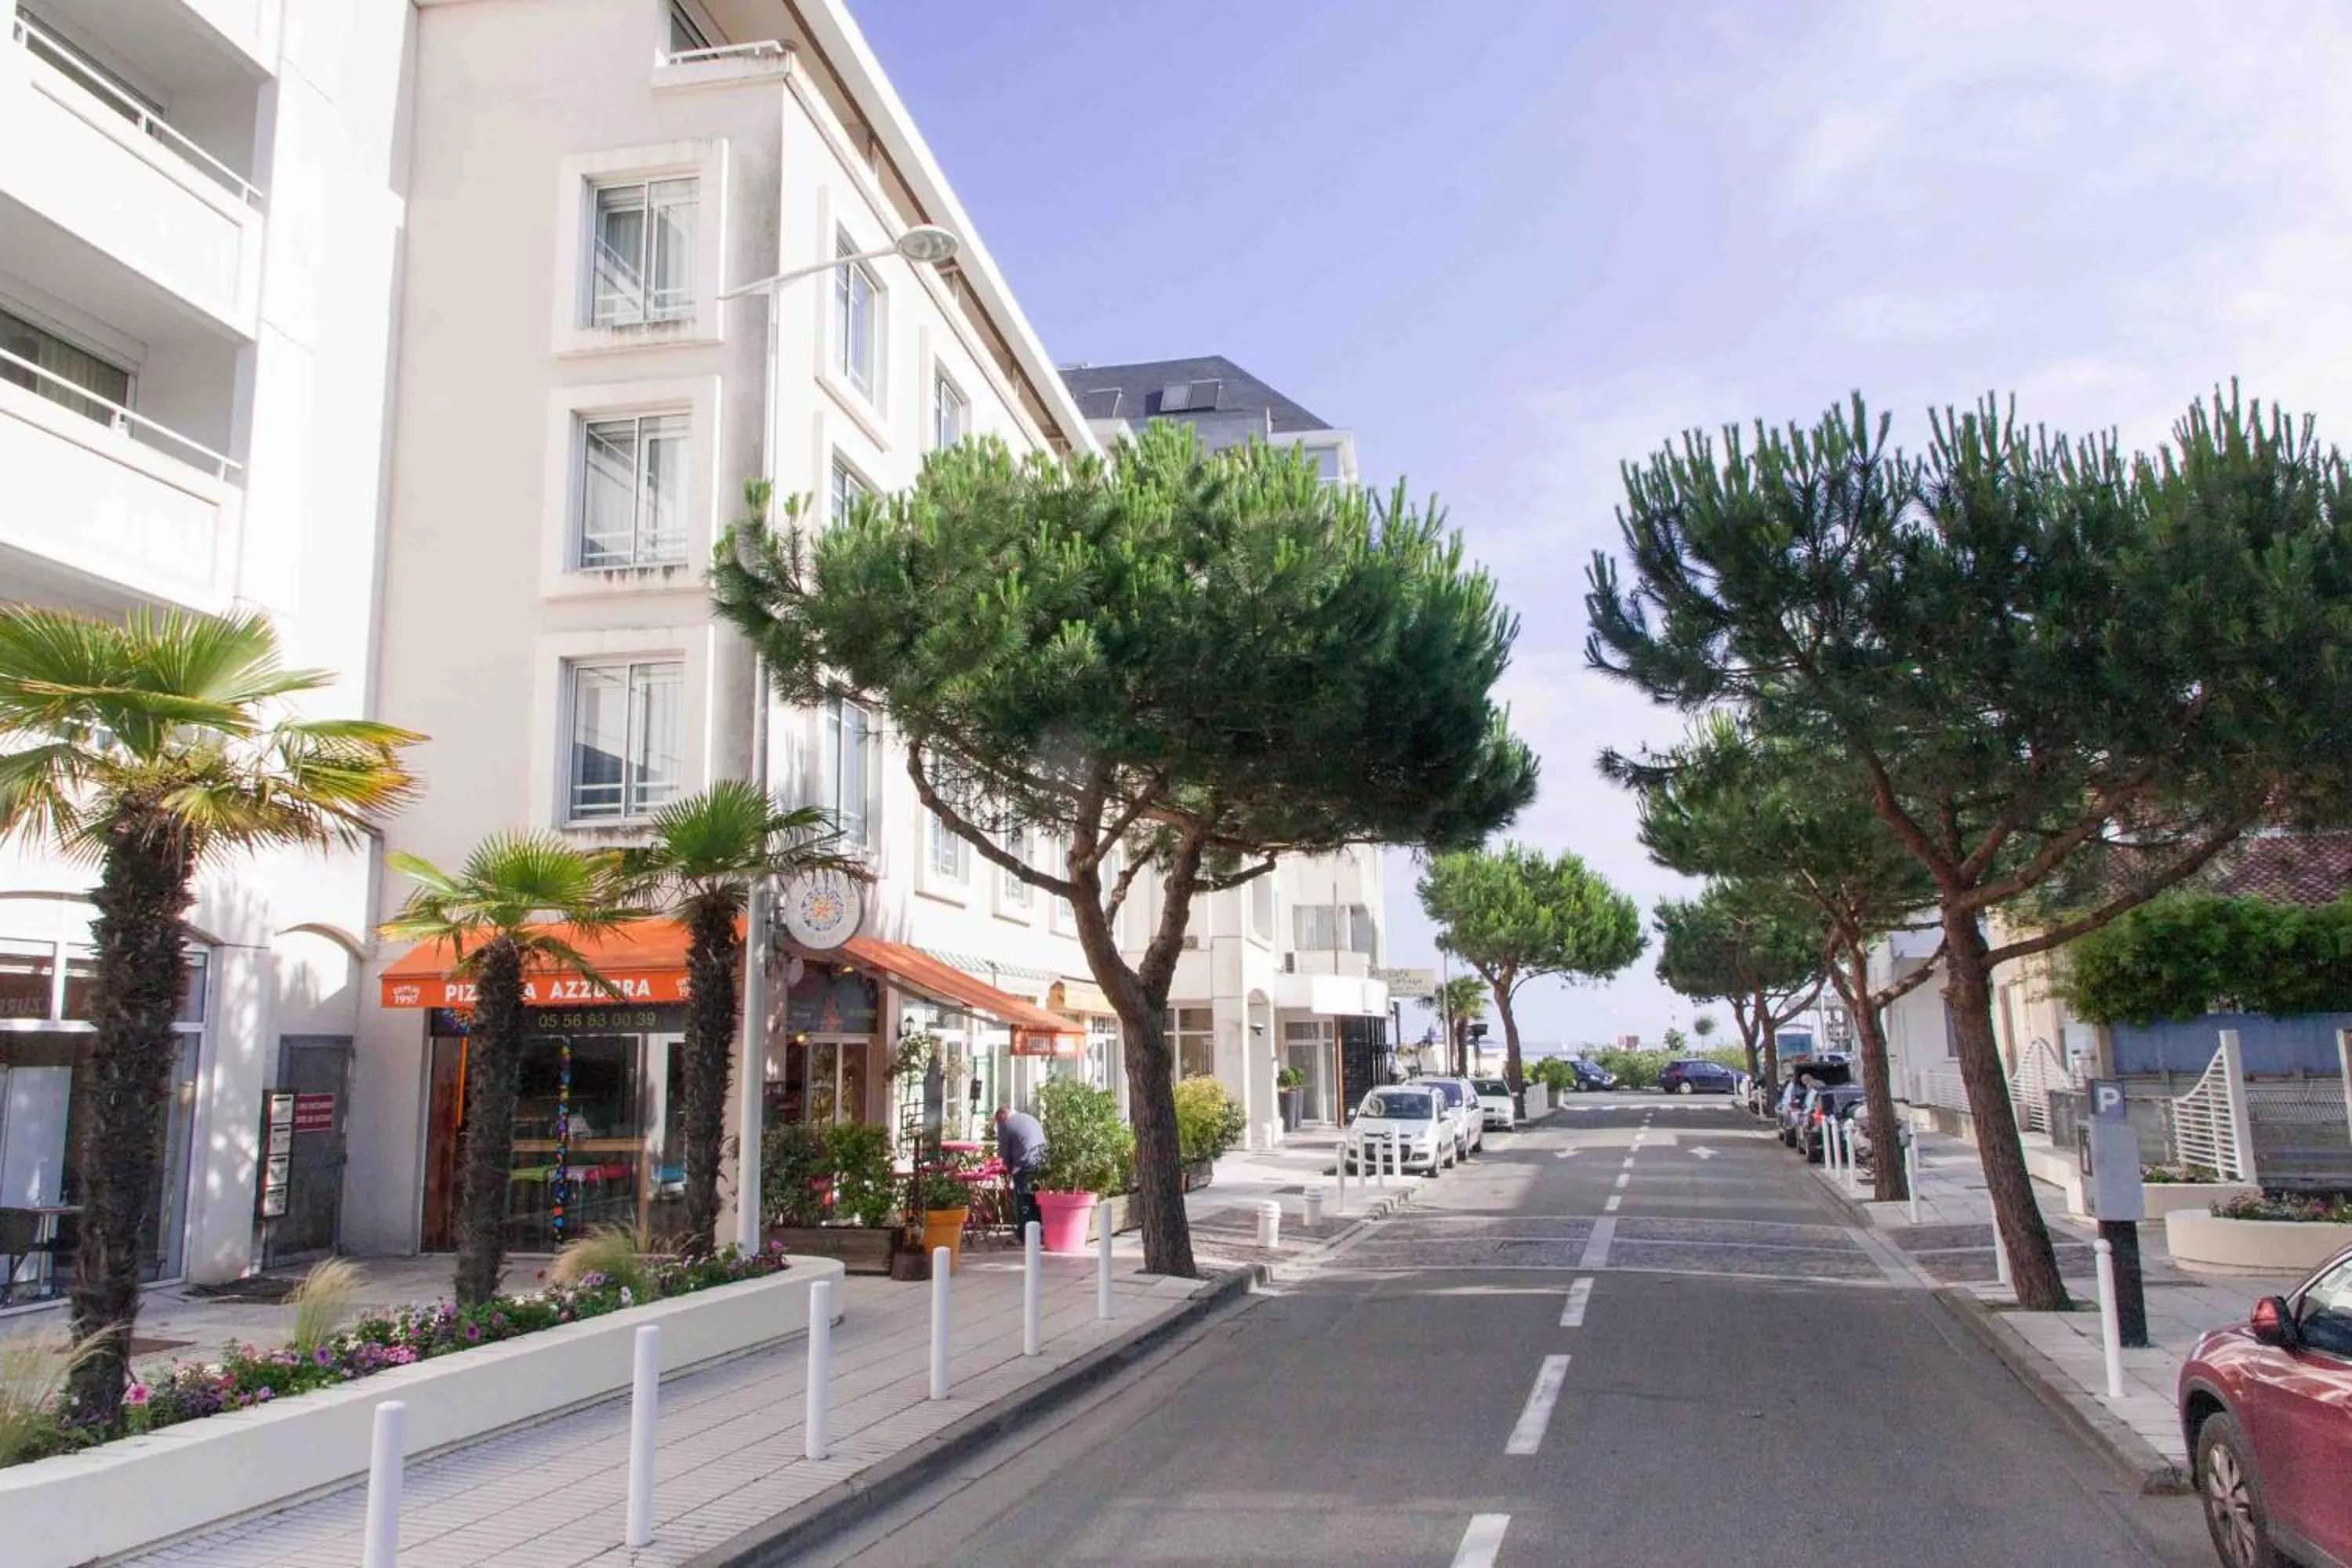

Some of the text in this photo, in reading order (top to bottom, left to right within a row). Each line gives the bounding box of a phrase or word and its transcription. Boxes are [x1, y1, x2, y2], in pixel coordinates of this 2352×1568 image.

[539, 1013, 557, 1029] 05
[562, 1013, 582, 1028] 56
[587, 1012, 607, 1027] 83
[612, 1011, 630, 1026] 00
[2098, 1087, 2120, 1112] P
